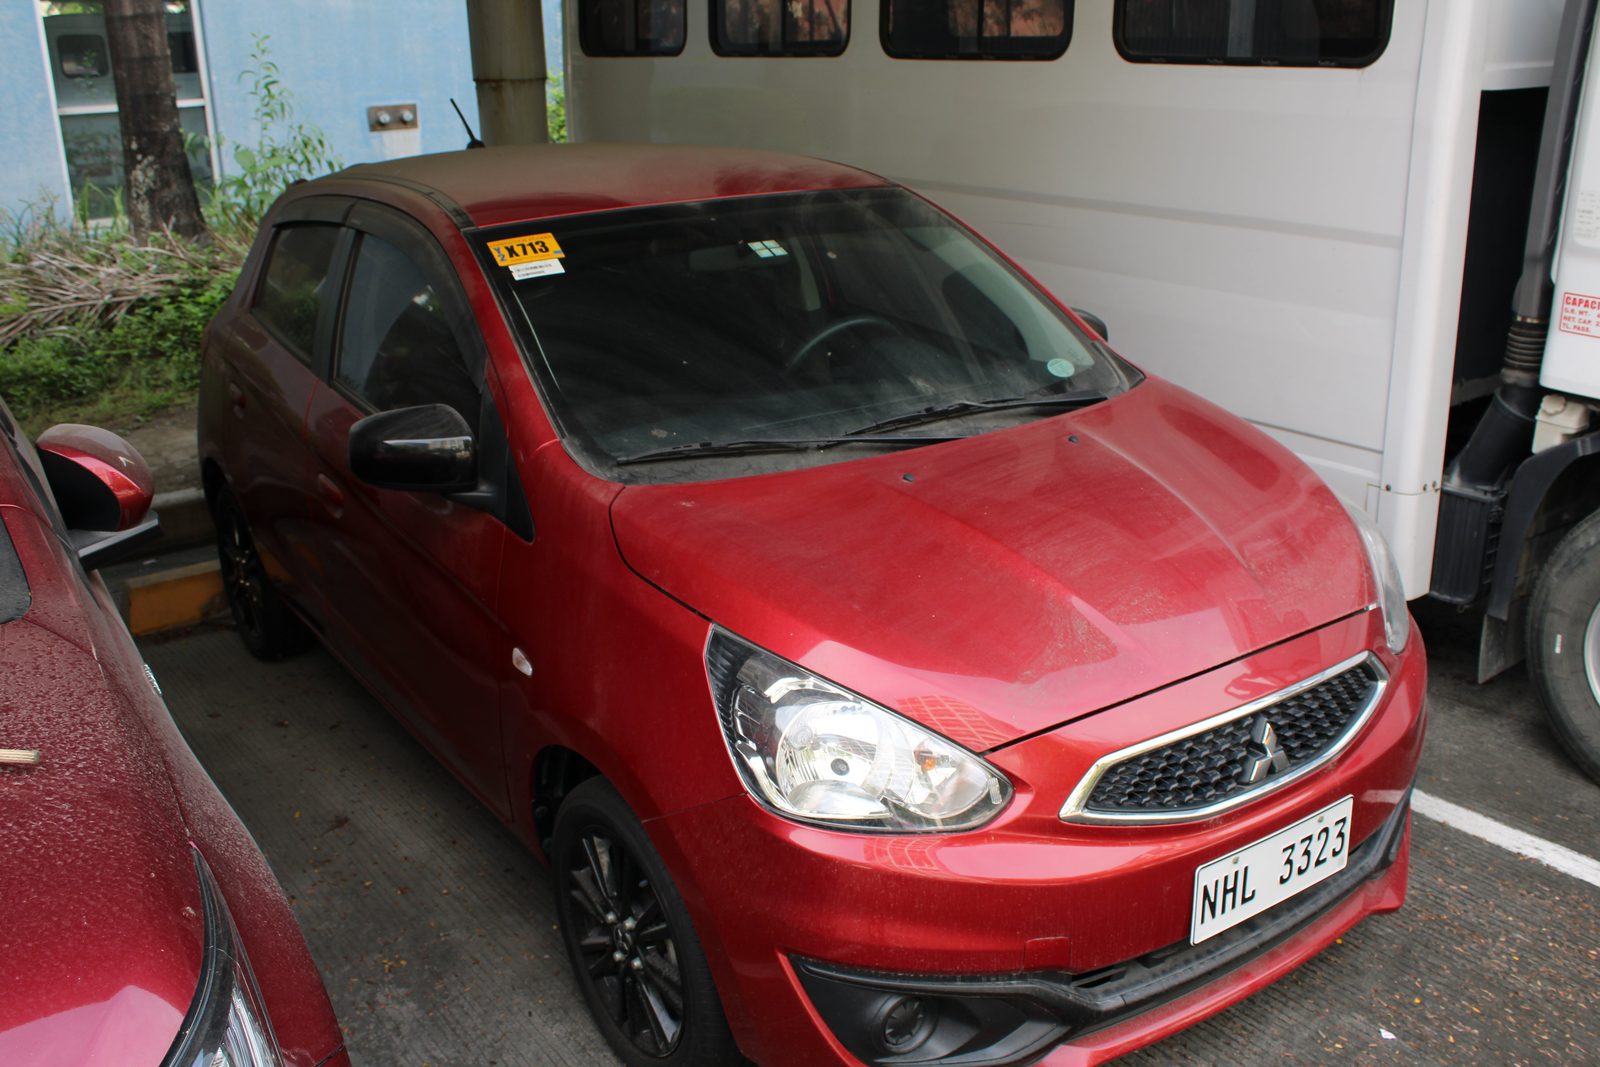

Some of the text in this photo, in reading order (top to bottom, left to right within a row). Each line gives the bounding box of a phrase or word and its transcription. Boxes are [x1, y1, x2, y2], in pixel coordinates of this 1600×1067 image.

[504, 240, 550, 258] X713
[1201, 816, 1347, 925] NHL 3323
